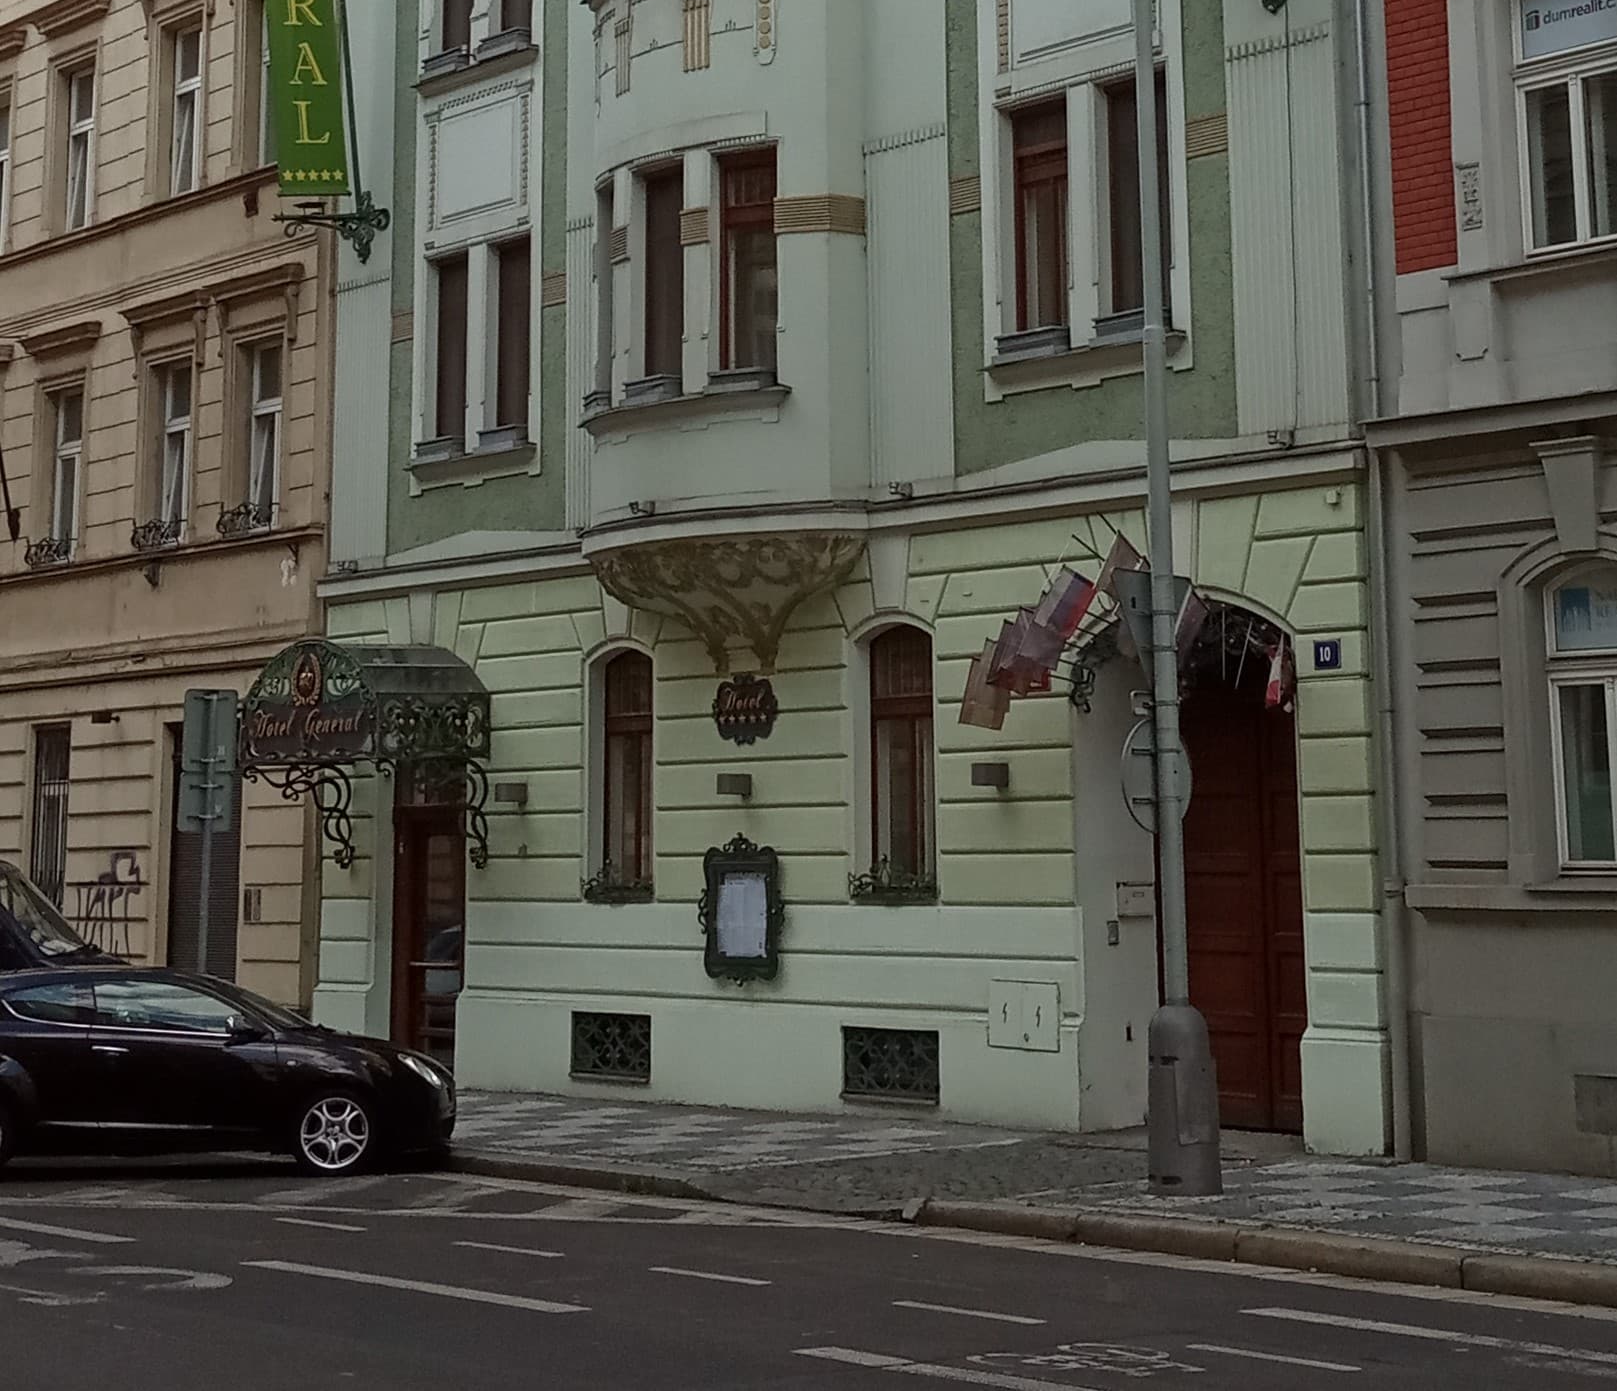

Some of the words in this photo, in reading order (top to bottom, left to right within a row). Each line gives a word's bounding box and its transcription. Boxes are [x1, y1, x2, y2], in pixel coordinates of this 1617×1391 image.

[1319, 646, 1332, 663] 10
[724, 687, 766, 710] Hotel
[254, 709, 296, 738] Hotel
[305, 708, 363, 741] General
